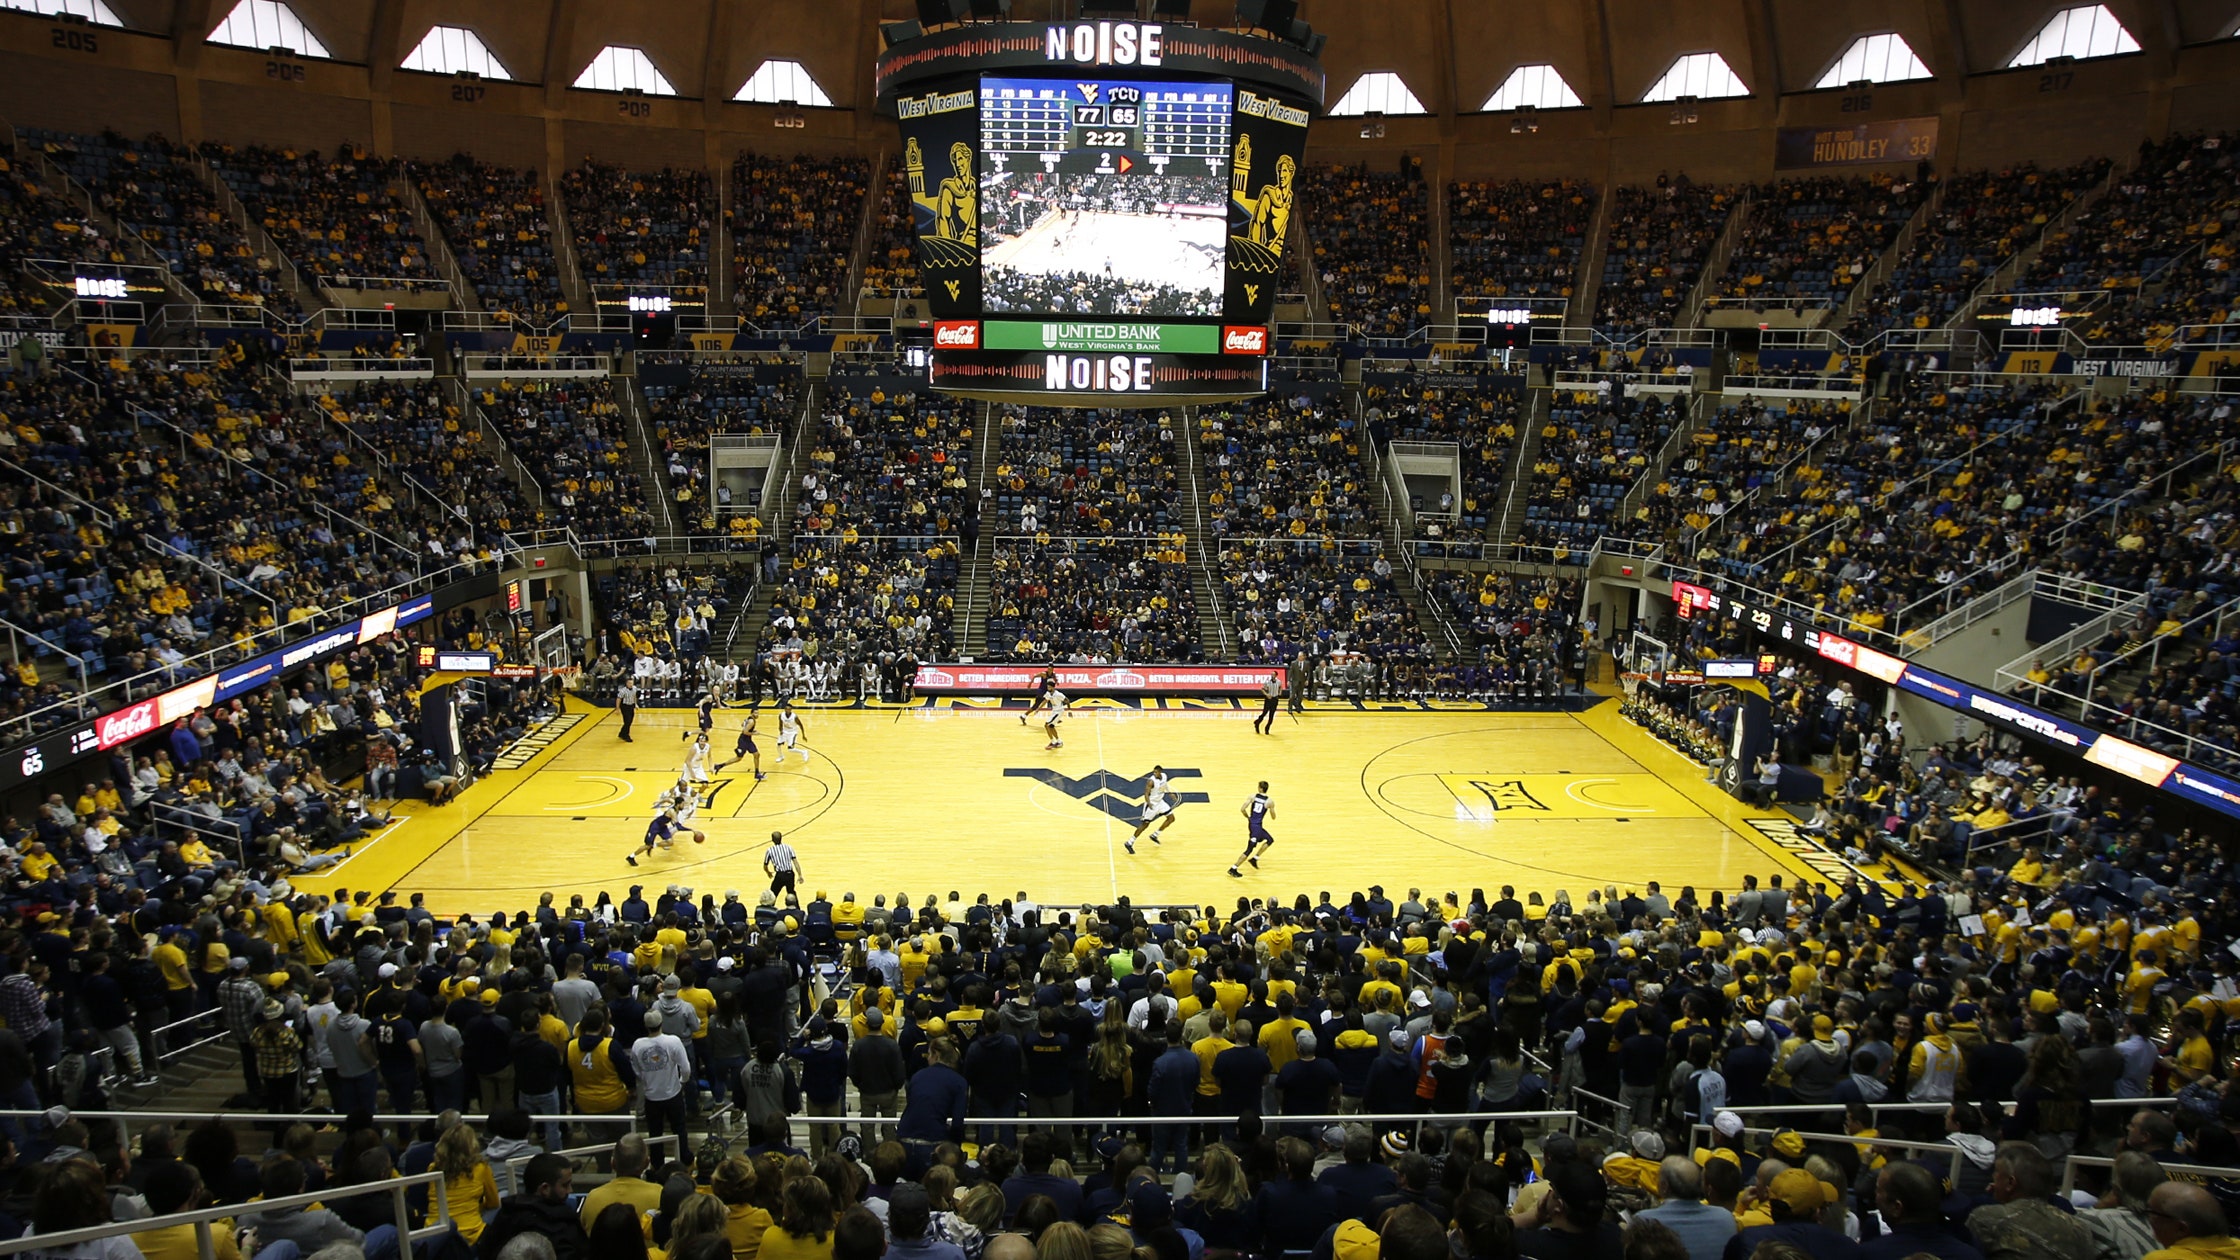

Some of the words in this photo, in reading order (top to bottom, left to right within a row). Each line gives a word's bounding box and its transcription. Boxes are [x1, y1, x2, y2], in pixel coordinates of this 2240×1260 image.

[52, 28, 97, 53] 205
[1047, 22, 1162, 66] NOISE
[2039, 72, 2075, 93] 217
[452, 84, 485, 101] 207
[1108, 87, 1140, 103] TCU
[898, 97, 926, 119] WEST
[926, 92, 975, 114] VIRGINIA
[1238, 90, 1266, 117] WEST
[1266, 97, 1309, 127] VIRGINIA
[1077, 108, 1100, 122] 77
[1112, 109, 1136, 124] 65
[1086, 131, 1126, 147] 2:22
[1909, 136, 1930, 156] 33
[1813, 138, 1889, 161] HUNDLEY
[995, 161, 1003, 172] 3
[1045, 162, 1054, 173] 9
[1101, 153, 1110, 167] 2
[75, 277, 128, 297] NOISE
[629, 296, 671, 311] NOISE
[1488, 308, 1530, 324] NOISE
[2010, 307, 2061, 326] NOISE
[936, 326, 975, 344] Coca-Cola
[1058, 325, 1118, 340] UNITED
[1119, 325, 1161, 340] BANK
[1226, 331, 1262, 350] Coca-Cola
[526, 337, 549, 350] 105
[699, 340, 721, 351] 106
[1059, 341, 1085, 349] WEST
[1046, 354, 1152, 391] NOISE
[2021, 359, 2040, 374] 113
[2073, 360, 2107, 376] WEST
[2110, 360, 2168, 376] VIRGINIA
[959, 674, 985, 682] BETTER
[1066, 673, 1092, 683] PIZZA.
[1149, 674, 1174, 683] BETTER
[1223, 675, 1254, 684] BETTER
[102, 704, 153, 745] Coca-Cola
[22, 754, 43, 776] 65
[592, 963, 610, 972] WVU
[379, 1025, 394, 1044] 13
[581, 1052, 593, 1070] 4
[752, 1064, 772, 1074] CSC
